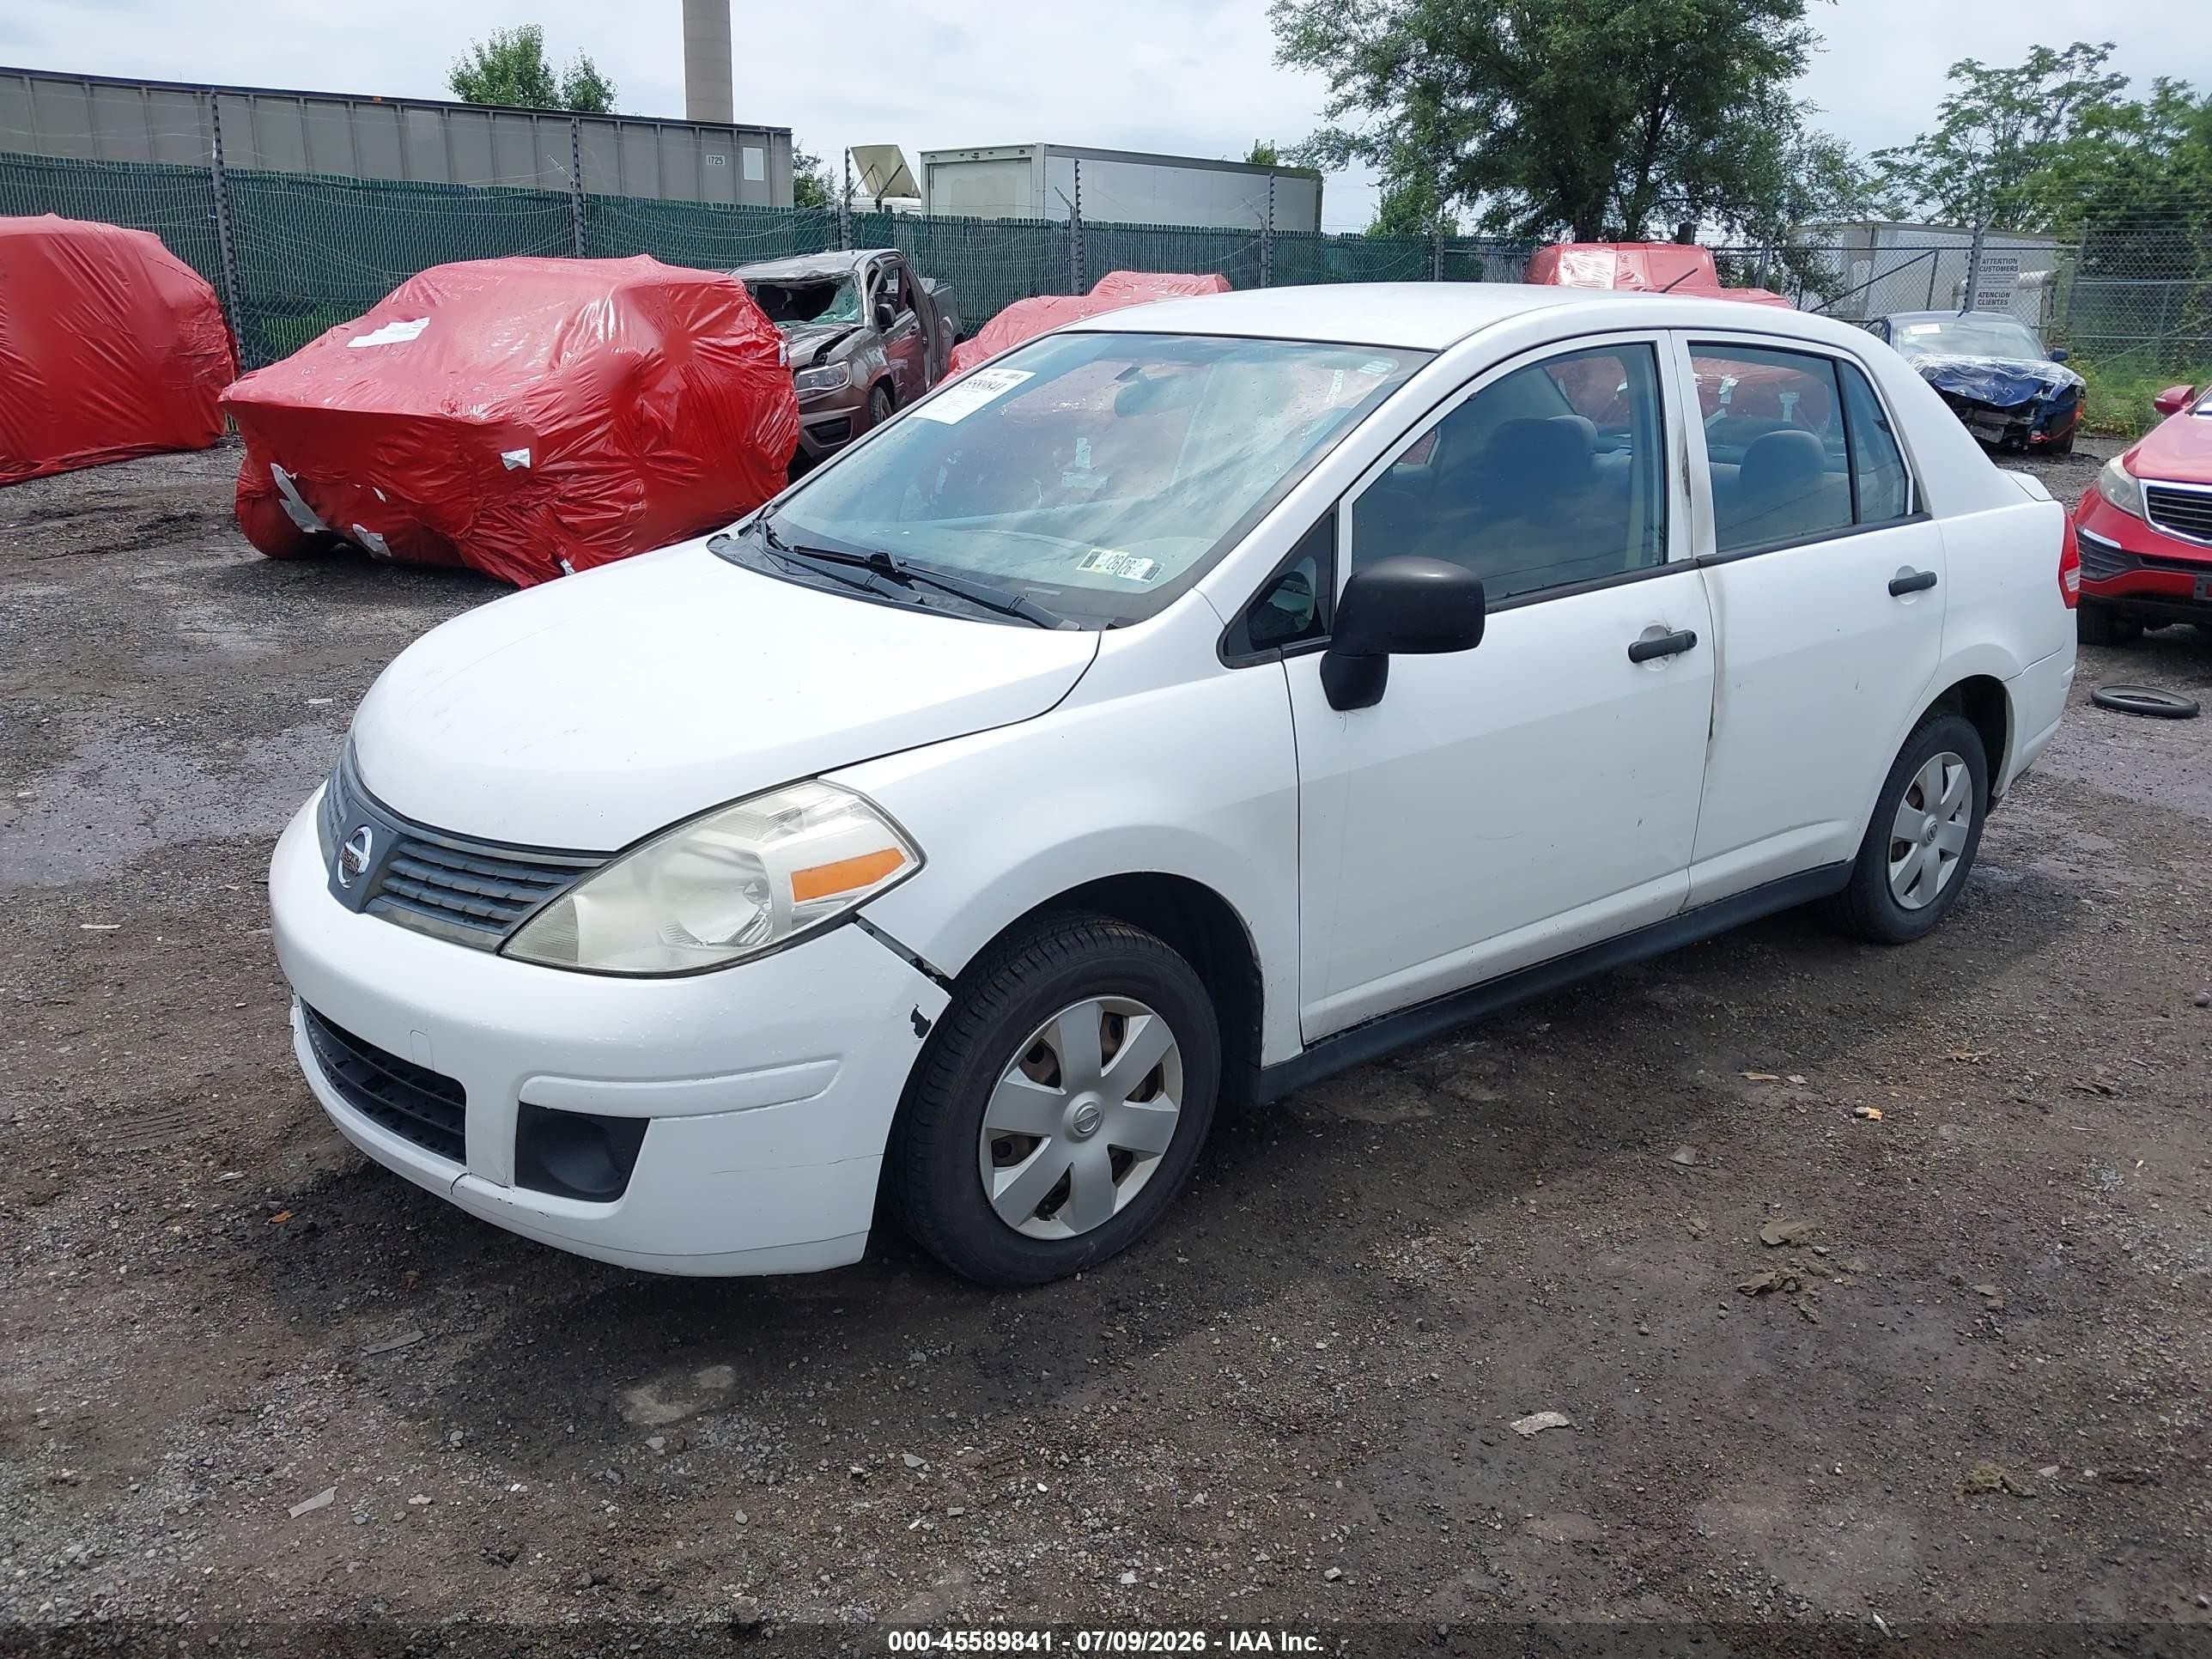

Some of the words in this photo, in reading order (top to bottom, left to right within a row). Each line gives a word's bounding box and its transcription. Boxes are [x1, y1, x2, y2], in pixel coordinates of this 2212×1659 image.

[708, 156, 723, 165] 1725
[1106, 555, 1124, 570] 26
[1119, 560, 1137, 575] 26
